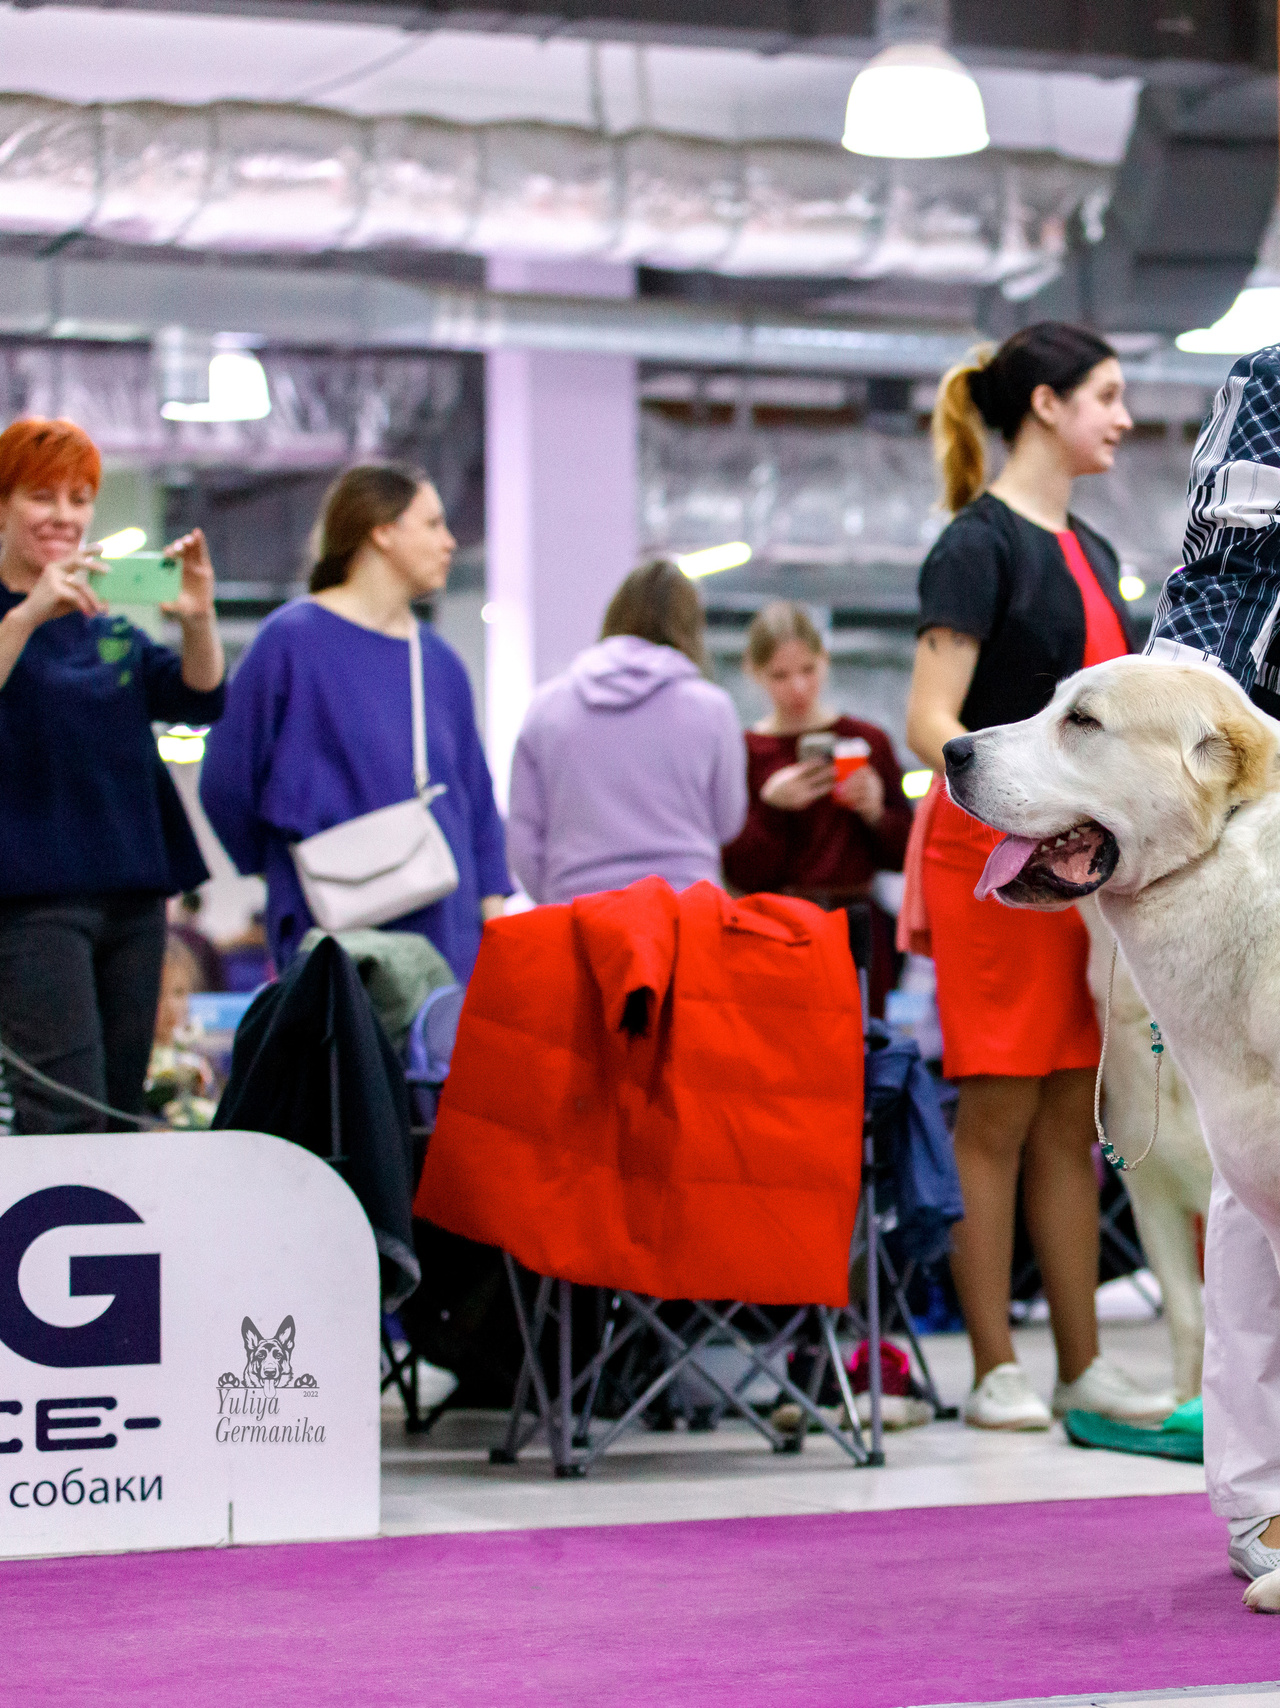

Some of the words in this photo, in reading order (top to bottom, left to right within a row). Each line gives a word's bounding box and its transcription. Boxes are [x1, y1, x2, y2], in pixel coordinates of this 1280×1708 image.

[0, 1184, 162, 1368] G
[0, 1396, 162, 1454] E-
[9, 1467, 164, 1509] собаки
